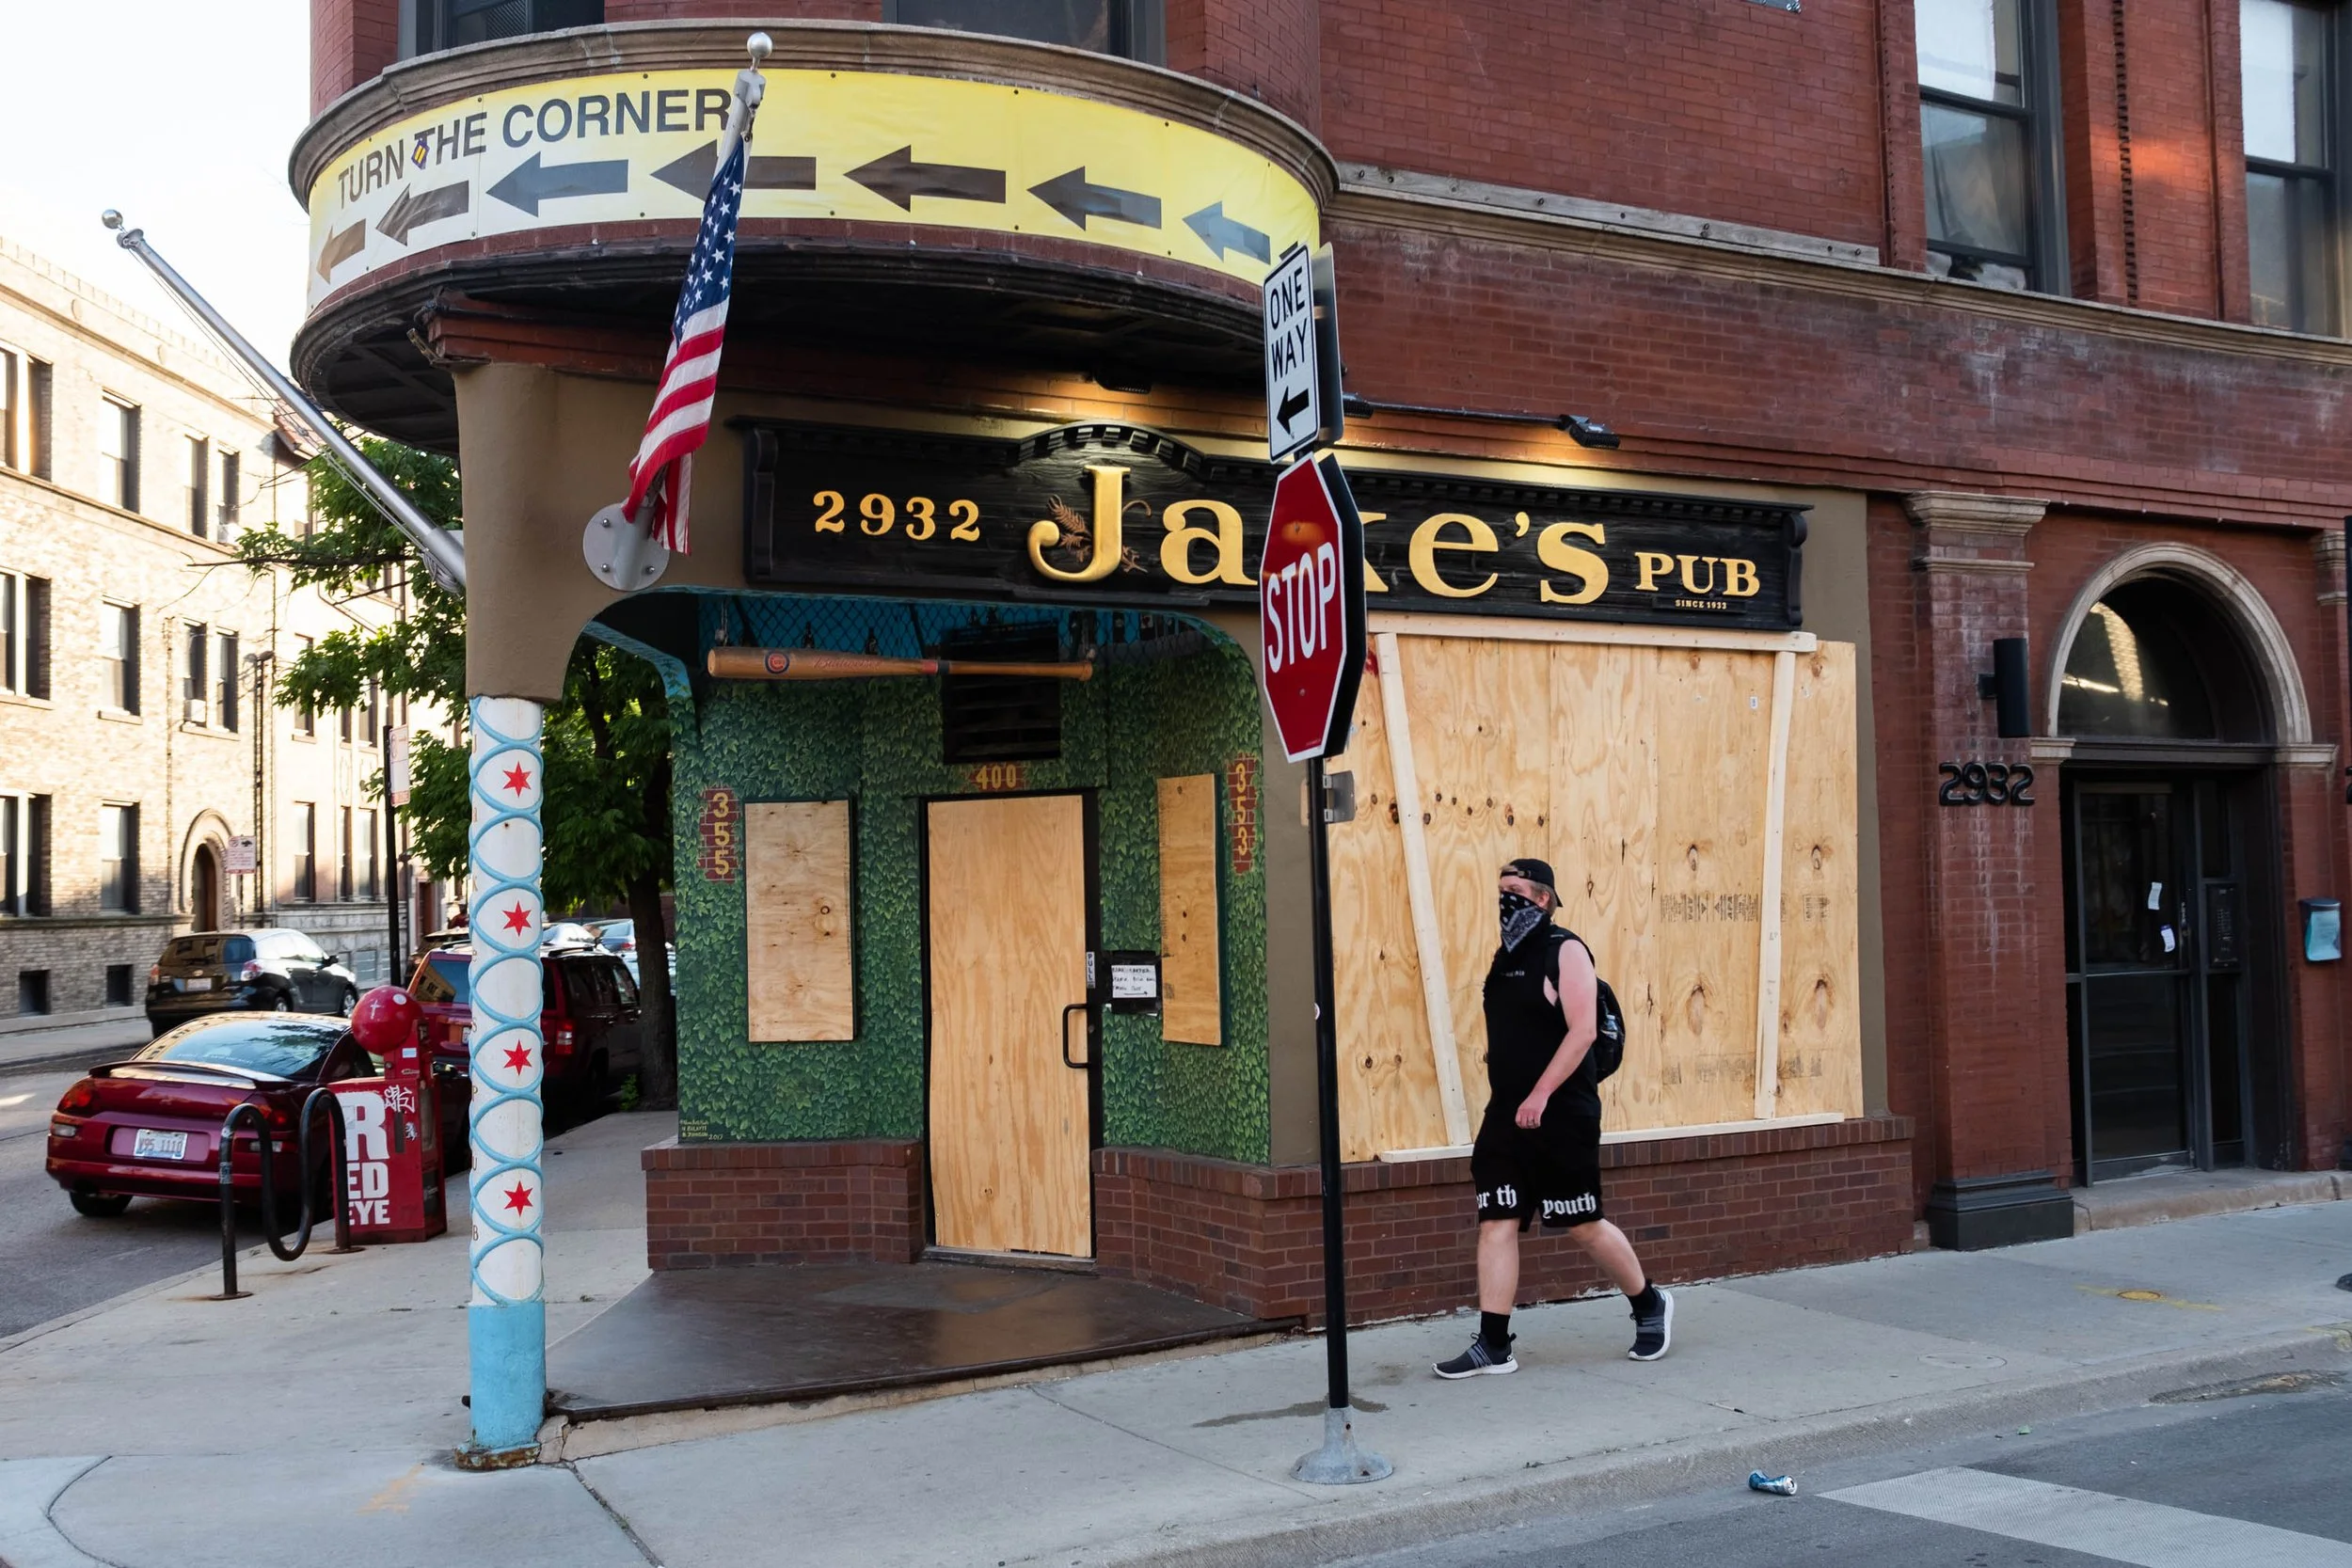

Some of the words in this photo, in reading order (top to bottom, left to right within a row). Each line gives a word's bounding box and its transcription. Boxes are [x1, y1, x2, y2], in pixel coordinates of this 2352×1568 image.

[338, 138, 405, 210] TURN
[411, 112, 487, 170] THE
[502, 88, 731, 148] CORNER
[1270, 266, 1305, 330] ONE
[1272, 318, 1308, 382] WAY
[813, 491, 980, 542] 2932
[1634, 552, 1760, 596] PUB
[1267, 542, 1336, 673] STOP
[1675, 599, 1704, 609] SINCE
[1707, 601, 1727, 610] 1933
[976, 764, 1016, 790] 400
[1939, 762, 2035, 806] 2932
[713, 792, 730, 875] 355
[1235, 763, 1248, 856] 353
[335, 1091, 389, 1161] R
[346, 1162, 389, 1199] ED
[1542, 1192, 1597, 1219] youth
